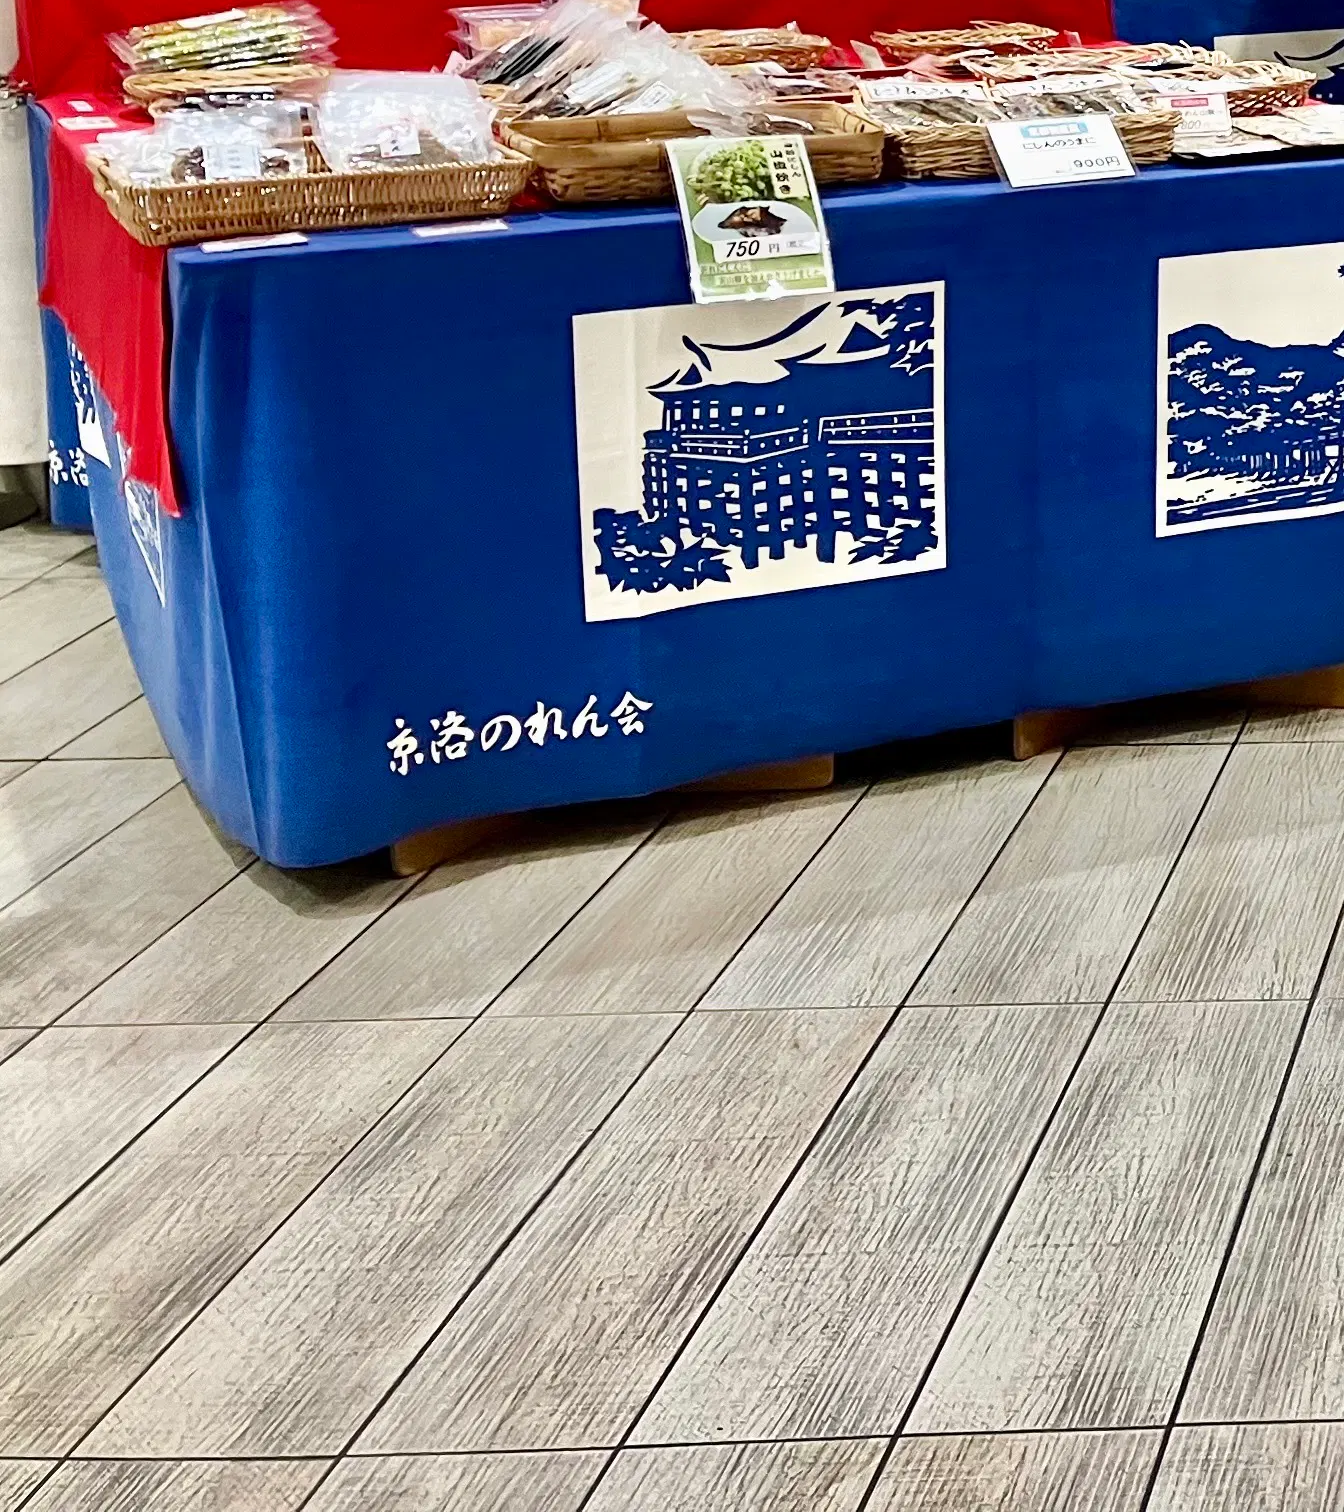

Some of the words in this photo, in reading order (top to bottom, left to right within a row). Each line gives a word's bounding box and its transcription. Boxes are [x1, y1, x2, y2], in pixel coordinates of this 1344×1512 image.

[385, 690, 654, 777] 京洛のれん会
